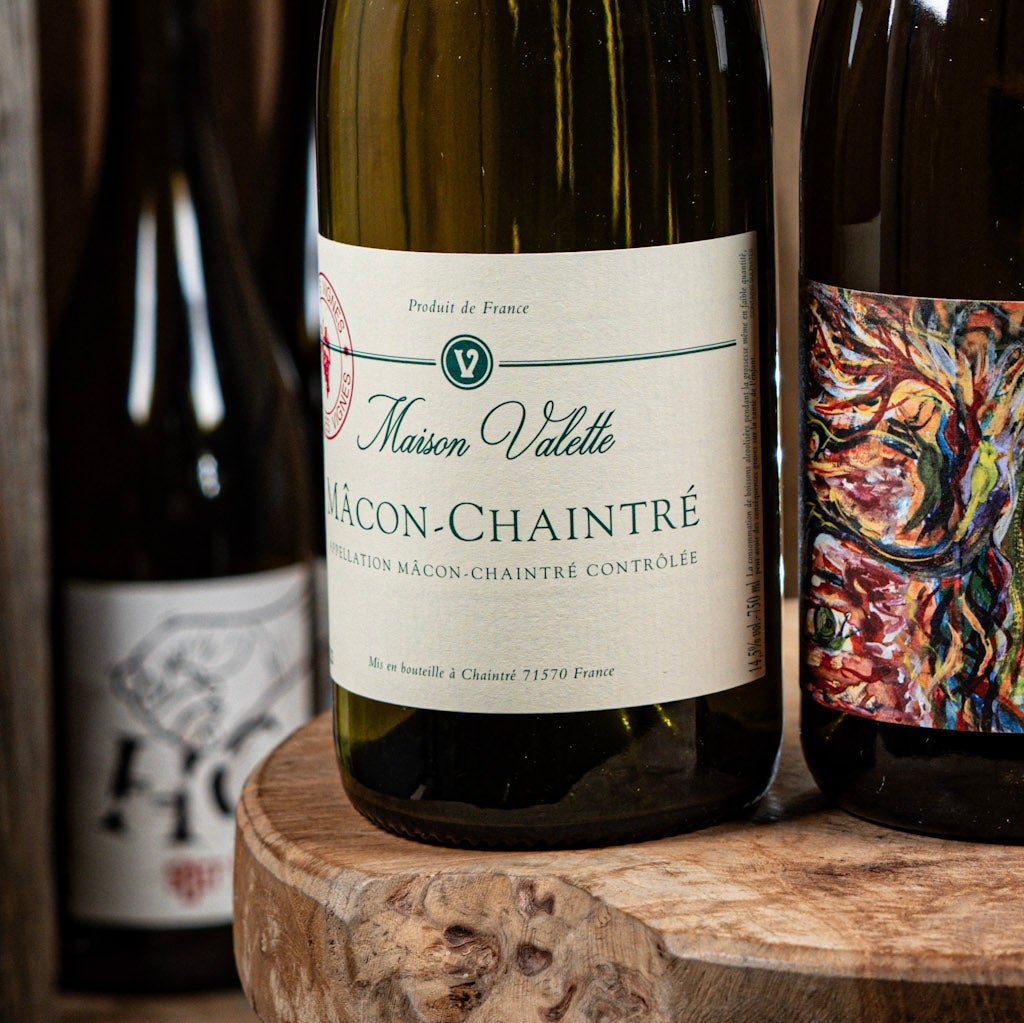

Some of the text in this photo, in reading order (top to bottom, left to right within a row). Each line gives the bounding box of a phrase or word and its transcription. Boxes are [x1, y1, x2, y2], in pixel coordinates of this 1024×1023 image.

[408, 299, 530, 315] Produit de France
[453, 348, 480, 378] V
[749, 388, 756, 397] de
[738, 249, 754, 577] La consommation de boissons alcoolisées pendant la grossesse même en faible quantité,
[749, 400, 757, 419] santé
[357, 394, 616, 460] Maison Valette
[750, 421, 757, 430] la
[326, 476, 701, 543] MÂCON-CHAINTRÉ
[398, 559, 577, 581] MÂCON-CHAINTRÉ
[586, 549, 698, 577] CONTRÔLÉE
[745, 580, 761, 593] ml
[369, 656, 615, 681] Mis en bouteille à Chaintré 71570 France
[747, 638, 763, 672] 14,5%
